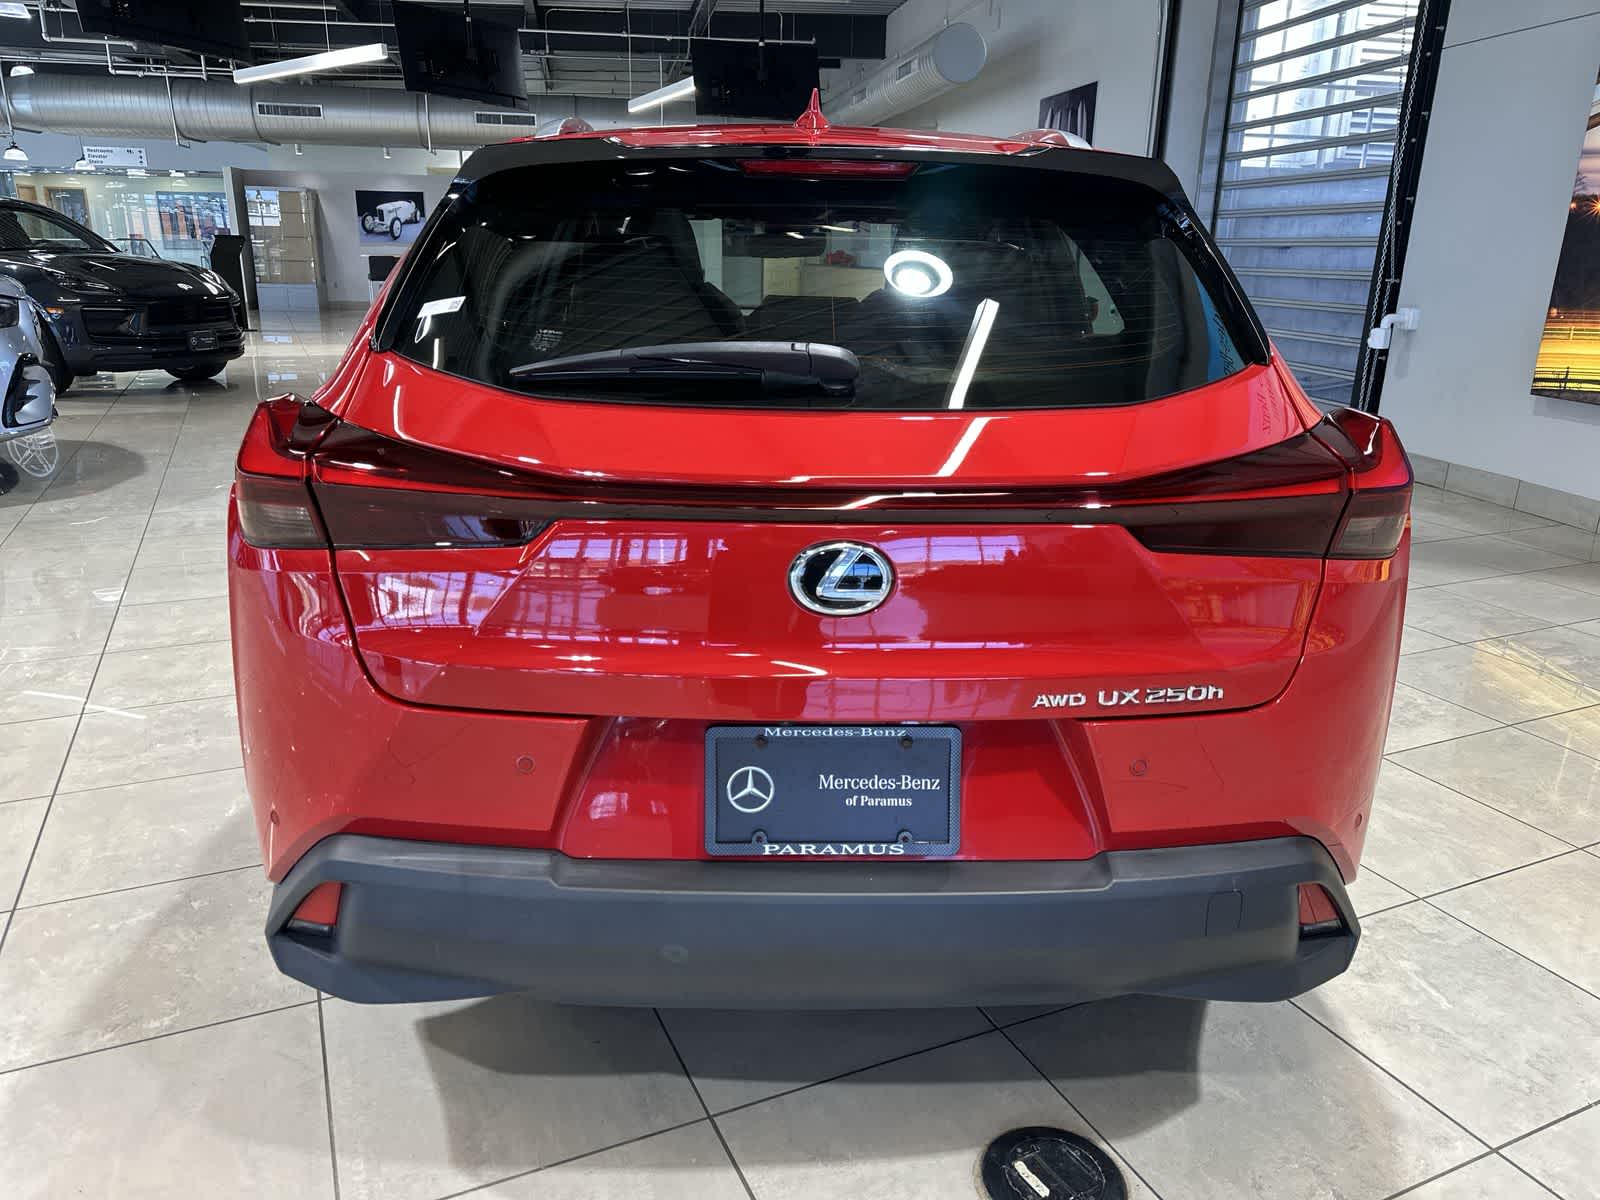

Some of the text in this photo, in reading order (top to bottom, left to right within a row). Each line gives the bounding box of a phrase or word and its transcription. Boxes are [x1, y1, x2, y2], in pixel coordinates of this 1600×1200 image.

[1032, 684, 1224, 708] AWD UX 250h
[763, 726, 907, 738] Mercedes-Benz
[818, 774, 941, 791] Mercedes-Benz
[845, 795, 913, 807] of Paramus
[762, 843, 906, 856] PARAMUS
